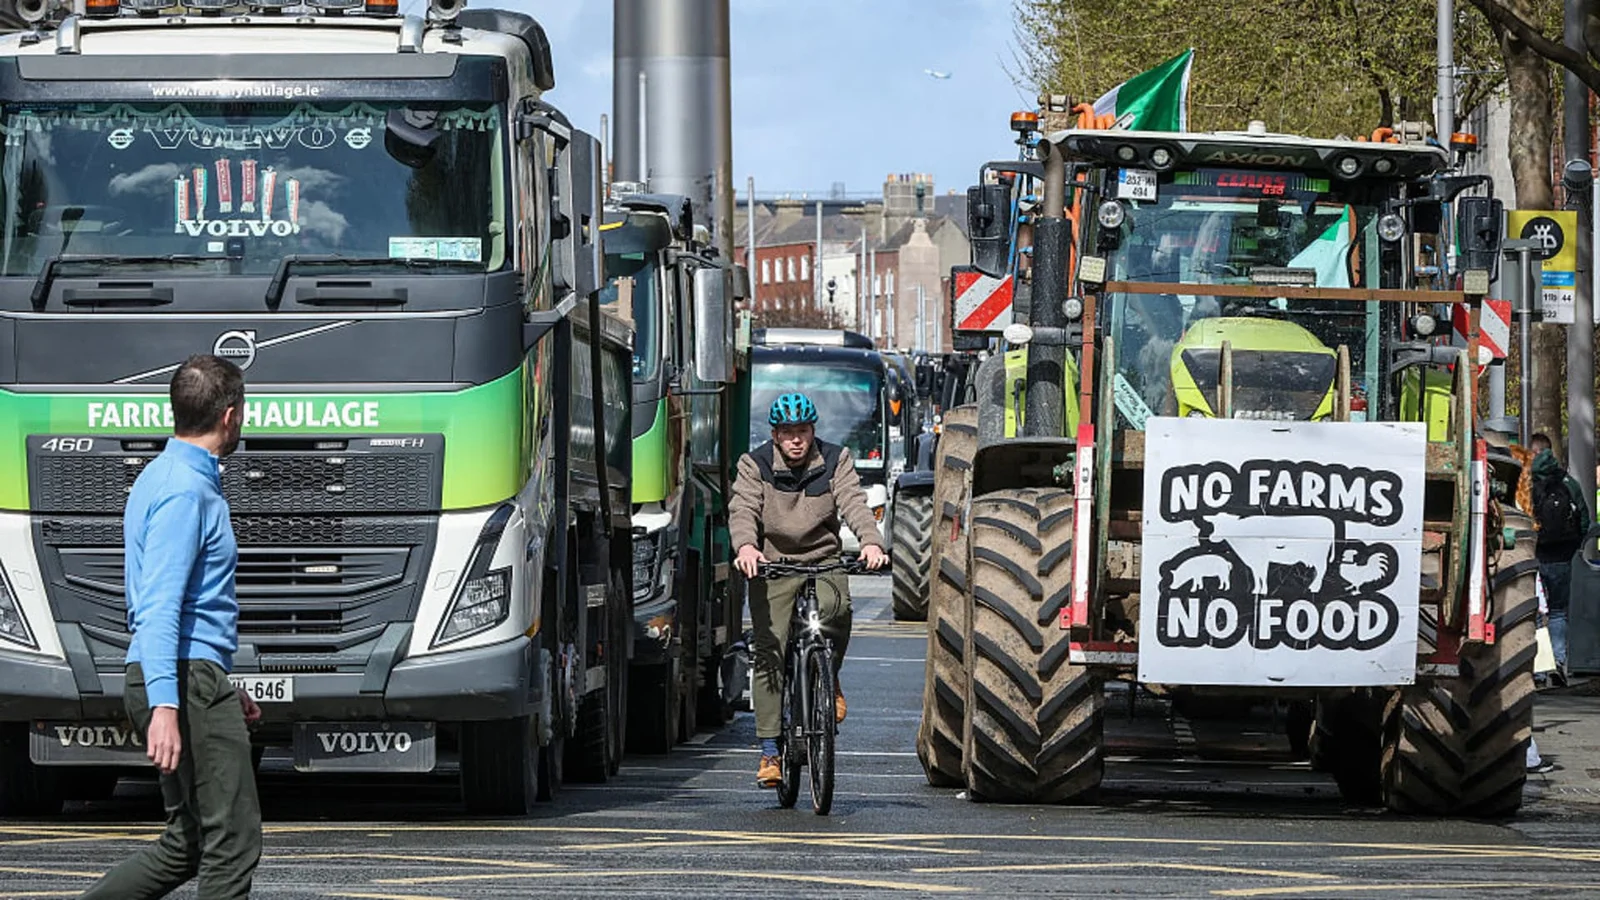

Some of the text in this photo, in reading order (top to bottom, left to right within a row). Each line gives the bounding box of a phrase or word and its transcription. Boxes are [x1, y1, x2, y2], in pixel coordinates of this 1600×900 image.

[1206, 151, 1306, 165] AXION
[181, 220, 292, 236] VOLVO
[88, 401, 379, 427] FARRE HAULAGE
[42, 438, 93, 453] 460
[1170, 470, 1393, 517] NO FARMS
[1167, 598, 1389, 642] NO FOOD
[317, 732, 412, 752] VOLVO
